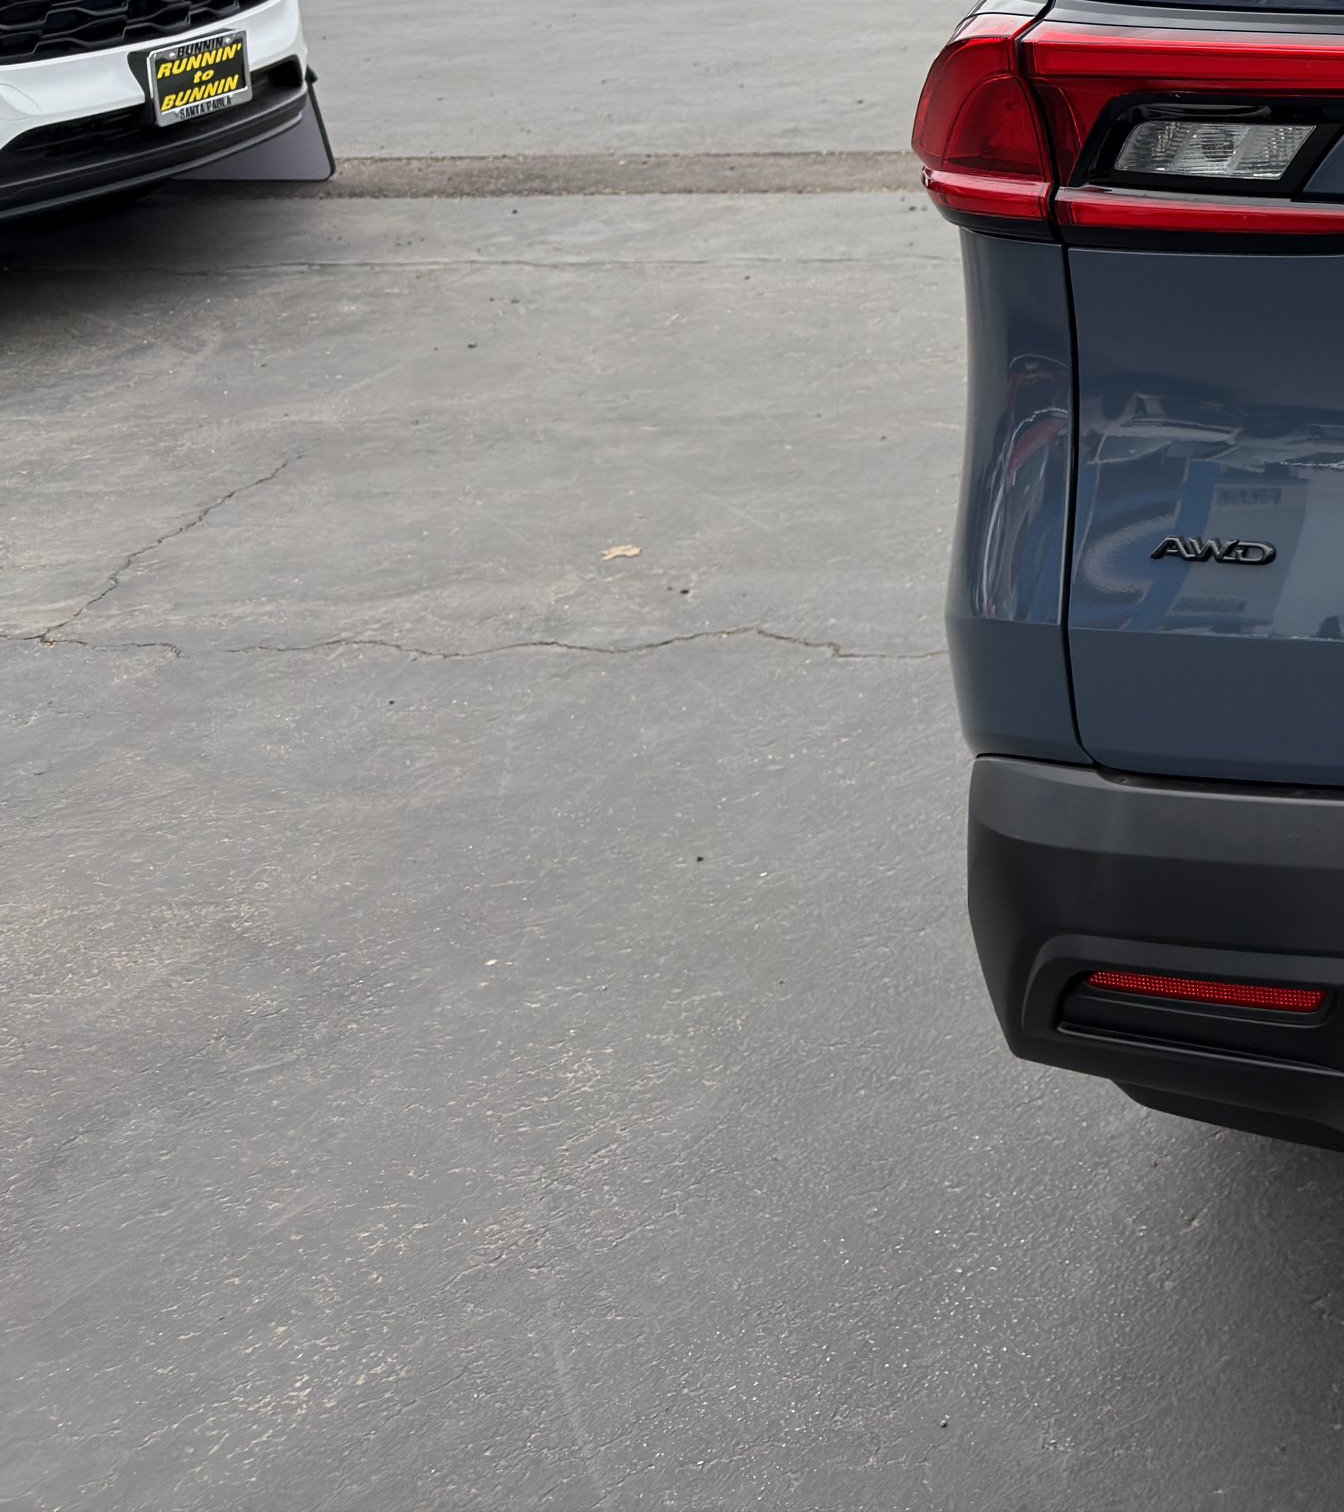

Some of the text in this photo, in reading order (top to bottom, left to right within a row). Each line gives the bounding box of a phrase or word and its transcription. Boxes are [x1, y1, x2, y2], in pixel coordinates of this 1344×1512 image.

[157, 43, 242, 79] RUNNIN'
[193, 69, 214, 84] to
[161, 74, 239, 111] BUNNIN
[1151, 535, 1277, 565] AWD
